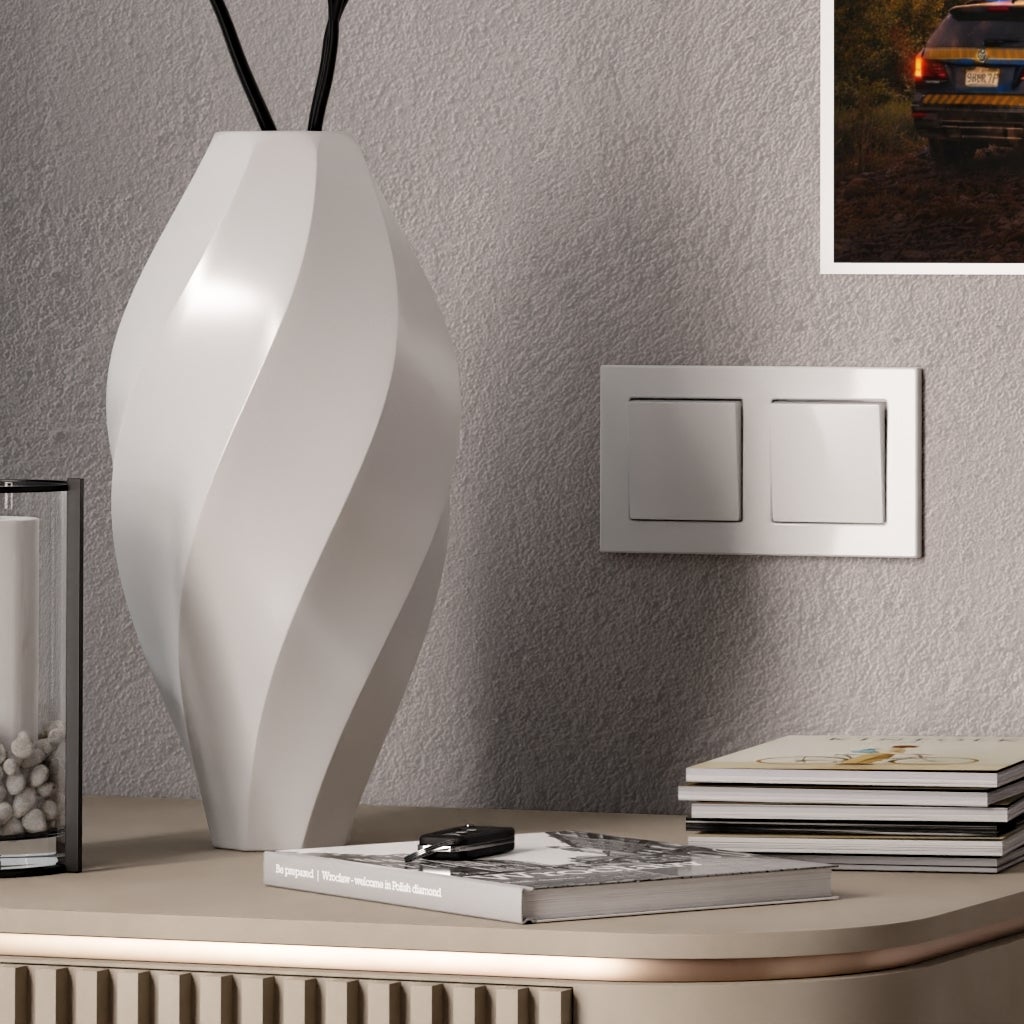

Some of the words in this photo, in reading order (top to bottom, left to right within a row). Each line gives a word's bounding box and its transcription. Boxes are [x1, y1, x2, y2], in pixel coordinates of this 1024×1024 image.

[275, 864, 284, 874] Be
[285, 867, 314, 879] prepared
[354, 876, 383, 889] welcome
[384, 880, 392, 890] in
[392, 881, 411, 893] Polish
[412, 884, 442, 897] diamond
